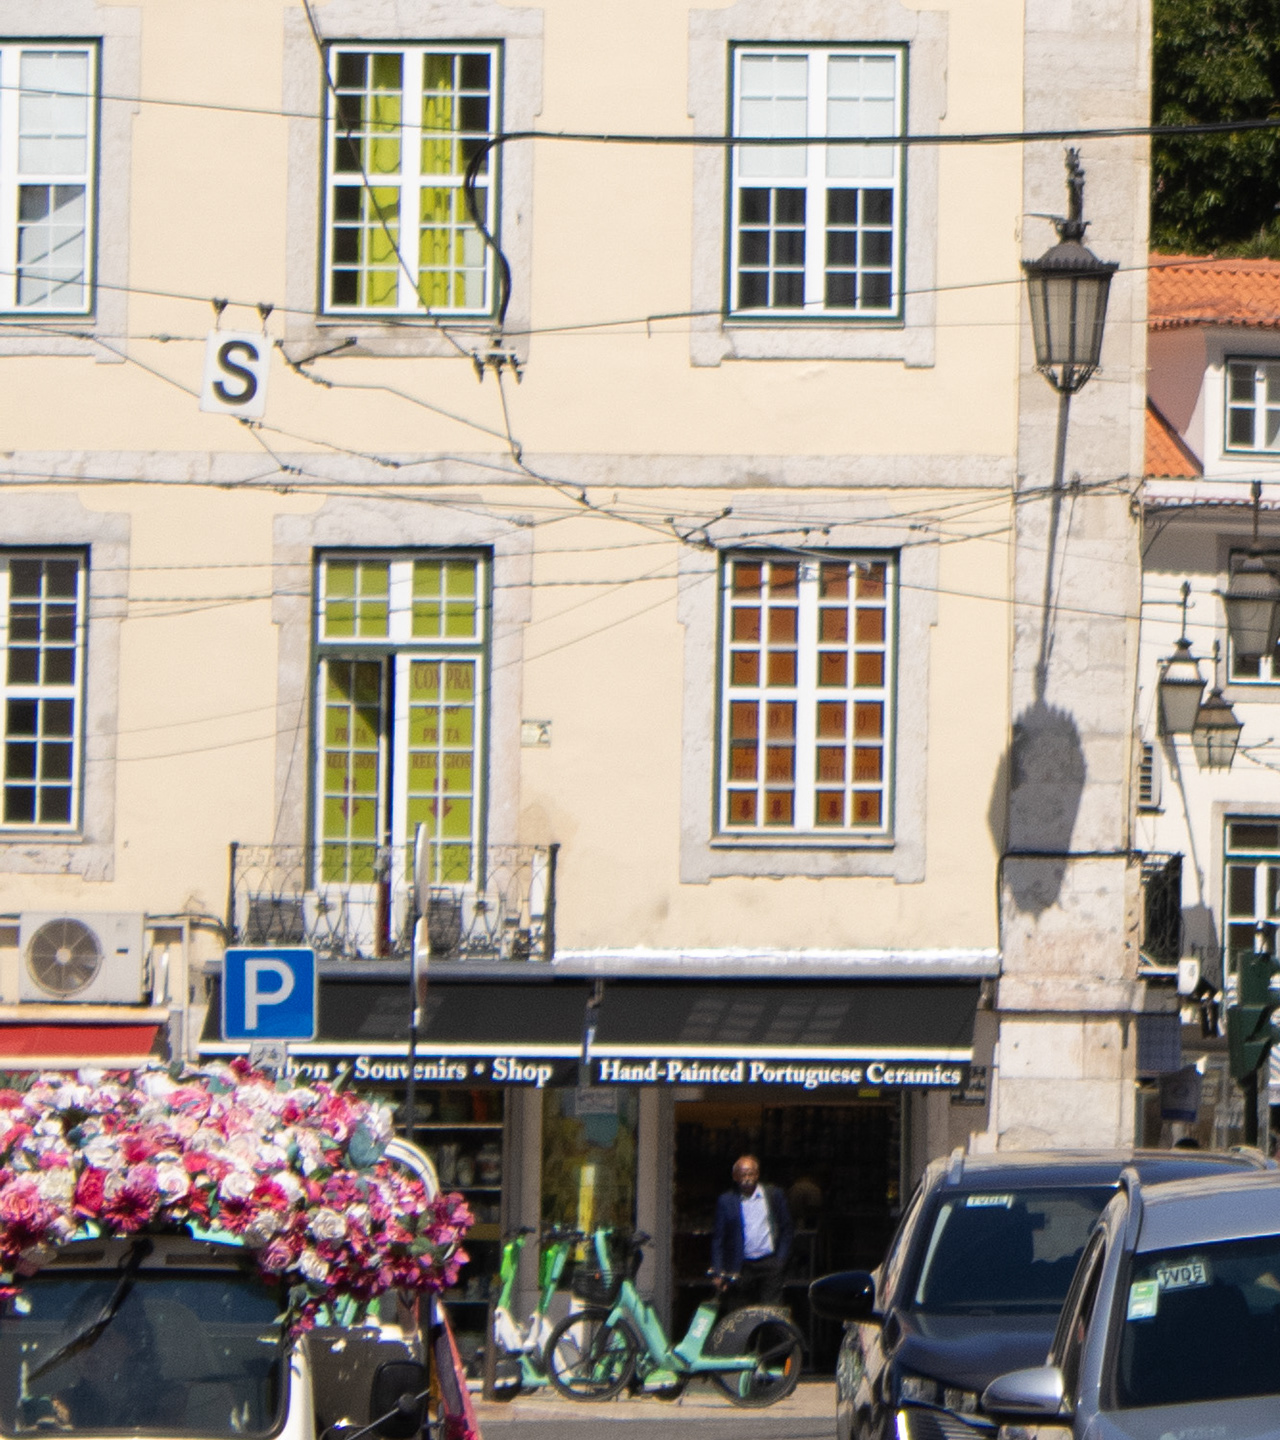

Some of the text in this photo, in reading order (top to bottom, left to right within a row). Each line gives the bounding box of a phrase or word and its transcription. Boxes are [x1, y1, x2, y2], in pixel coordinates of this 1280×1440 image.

[212, 339, 259, 406] S
[244, 958, 295, 1030] P
[492, 1058, 552, 1088] Shop
[600, 1060, 962, 1089] Hand-Painted Portuguese Ceramics
